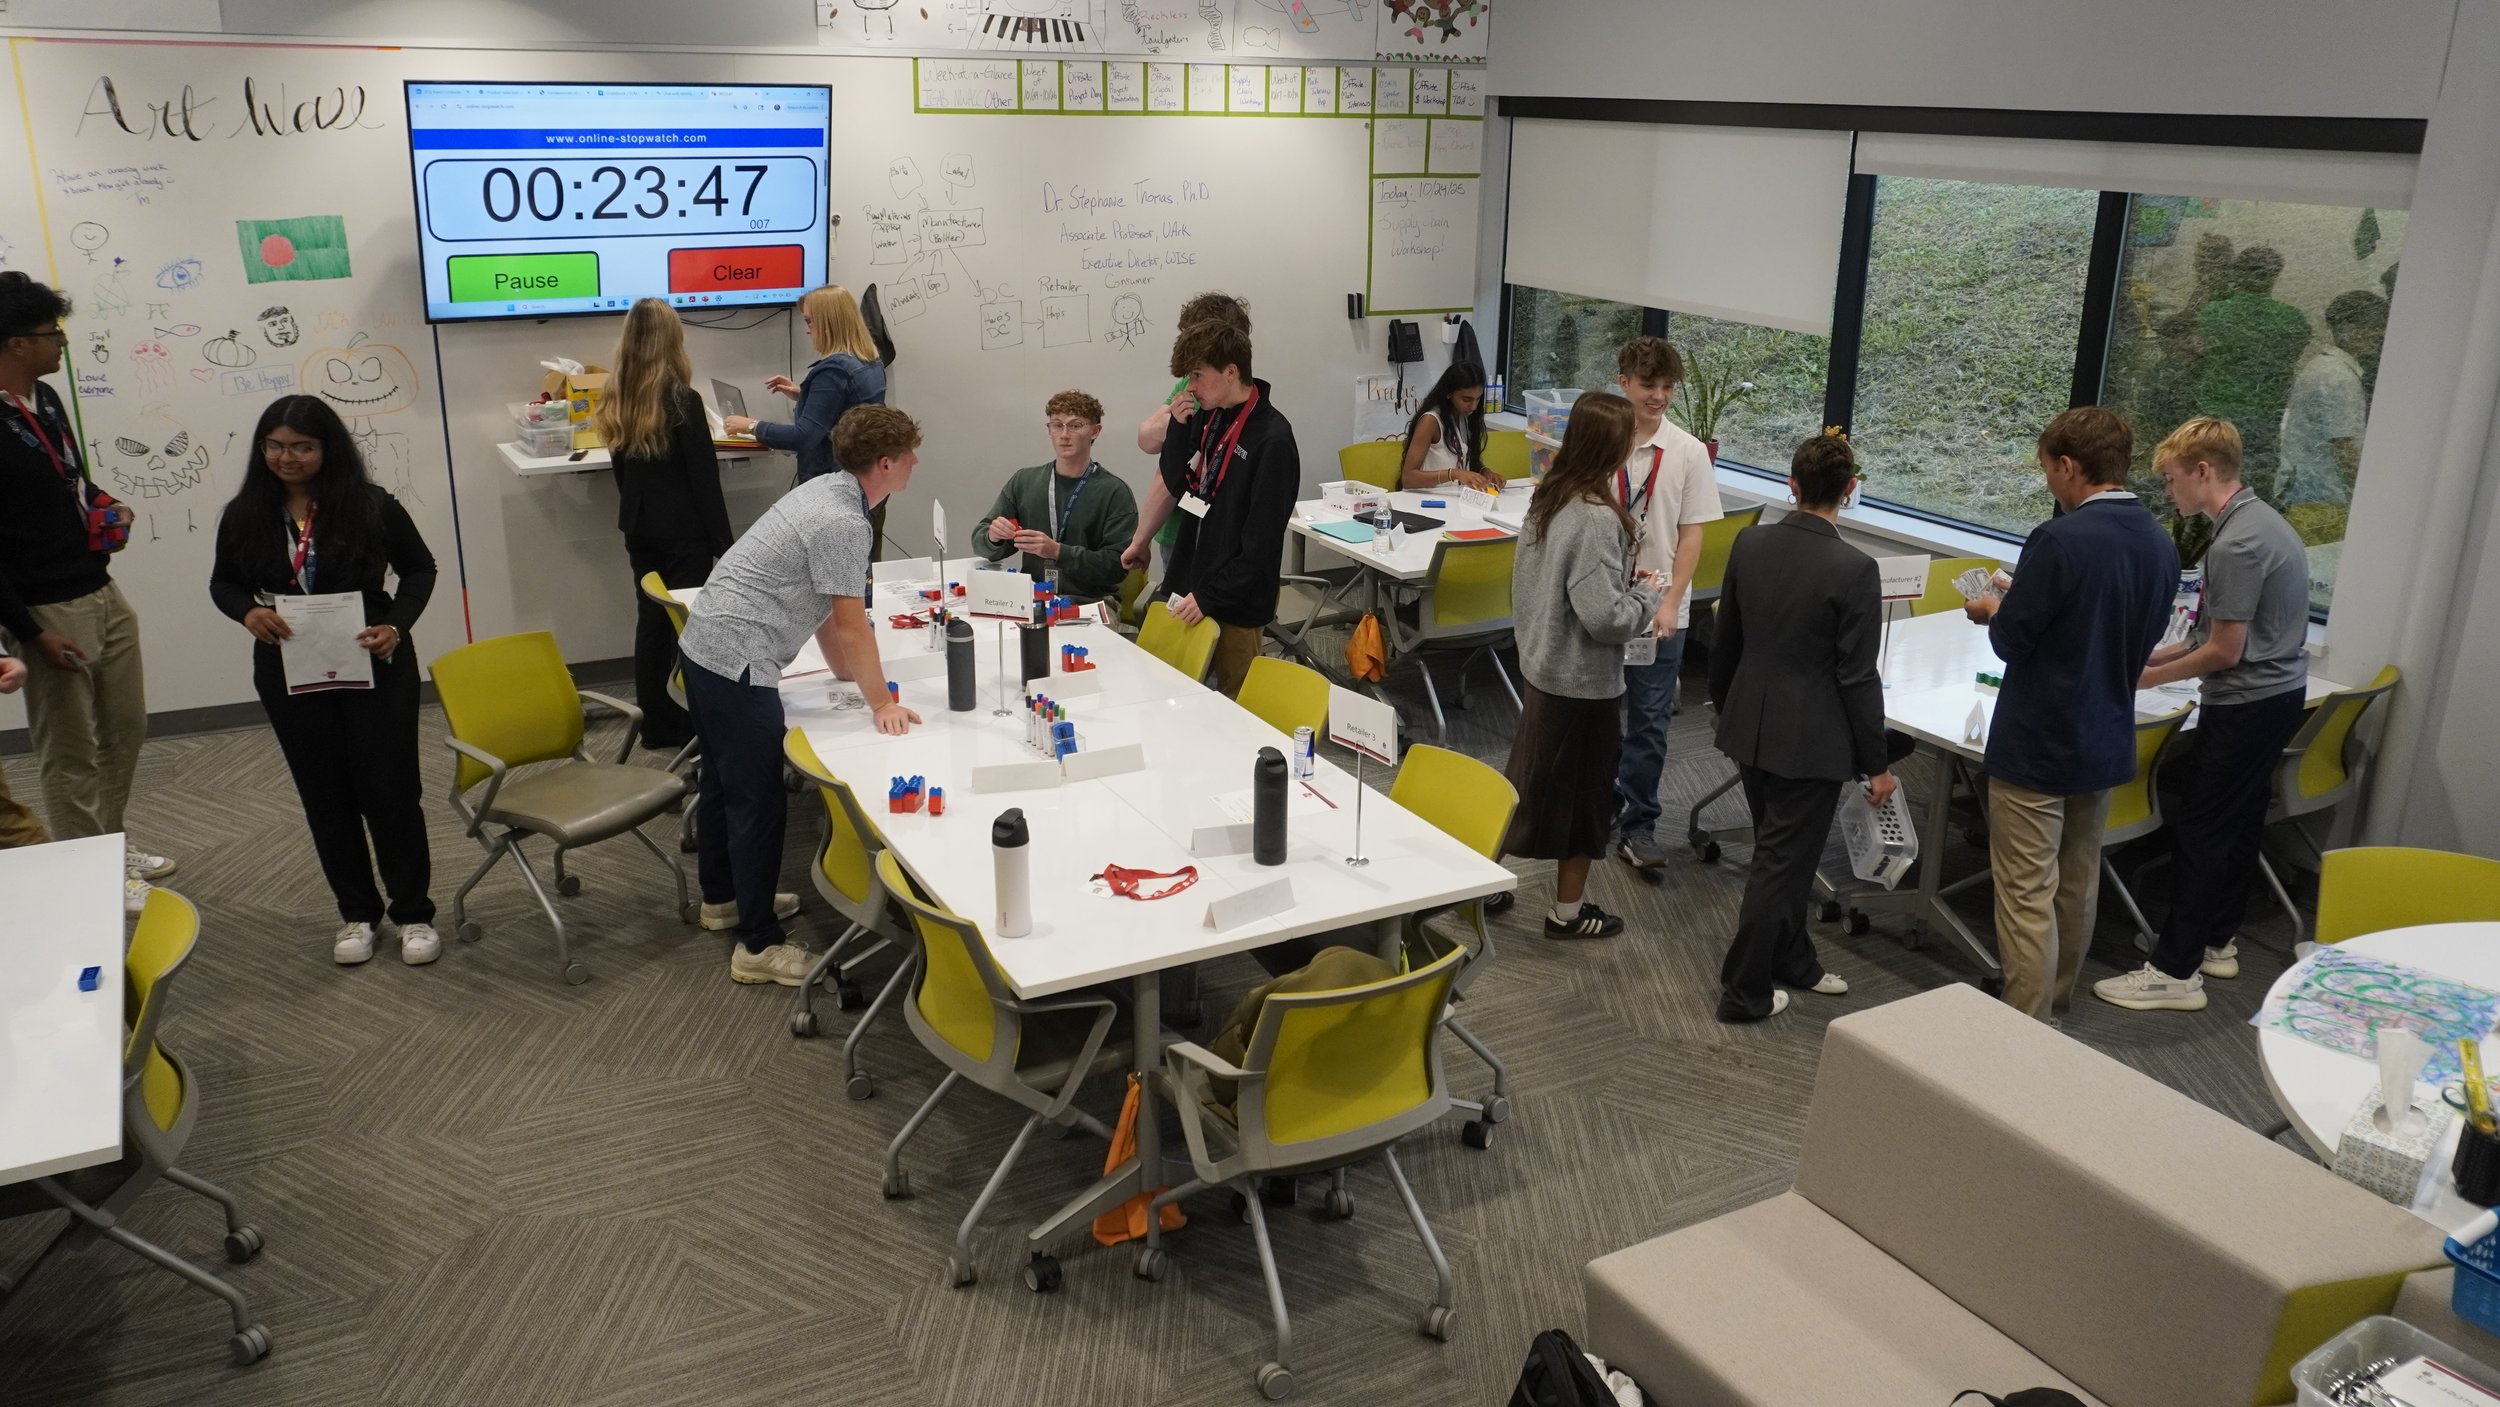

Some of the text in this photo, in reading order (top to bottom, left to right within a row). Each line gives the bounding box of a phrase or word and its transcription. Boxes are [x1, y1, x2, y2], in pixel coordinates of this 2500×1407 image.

[947, 24, 953, 34] 5
[1023, 63, 1048, 77] Week
[984, 88, 1012, 109] Other
[1090, 88, 1103, 104] Day
[75, 75, 385, 141] Art Wall
[545, 132, 707, 145] www.online-stopwatch.com
[482, 164, 768, 223] 00:23:47
[1043, 182, 1063, 213] Dr.
[1069, 185, 1126, 216] Stephanie
[1419, 181, 1465, 199] 10/24/25
[750, 218, 771, 230] 007
[1060, 222, 1108, 243] Associate
[1081, 248, 1124, 270] Executive
[1165, 250, 1198, 266] WISE
[494, 272, 559, 291] Pause
[713, 264, 762, 282] Clear
[1104, 272, 1156, 289] Consumer
[1038, 275, 1083, 295] Retailer
[986, 323, 1011, 339] DC
[77, 368, 108, 382] Love
[234, 371, 291, 394] Be Happy
[984, 598, 1009, 608] Retailer
[1346, 722, 1371, 738] Retailer
